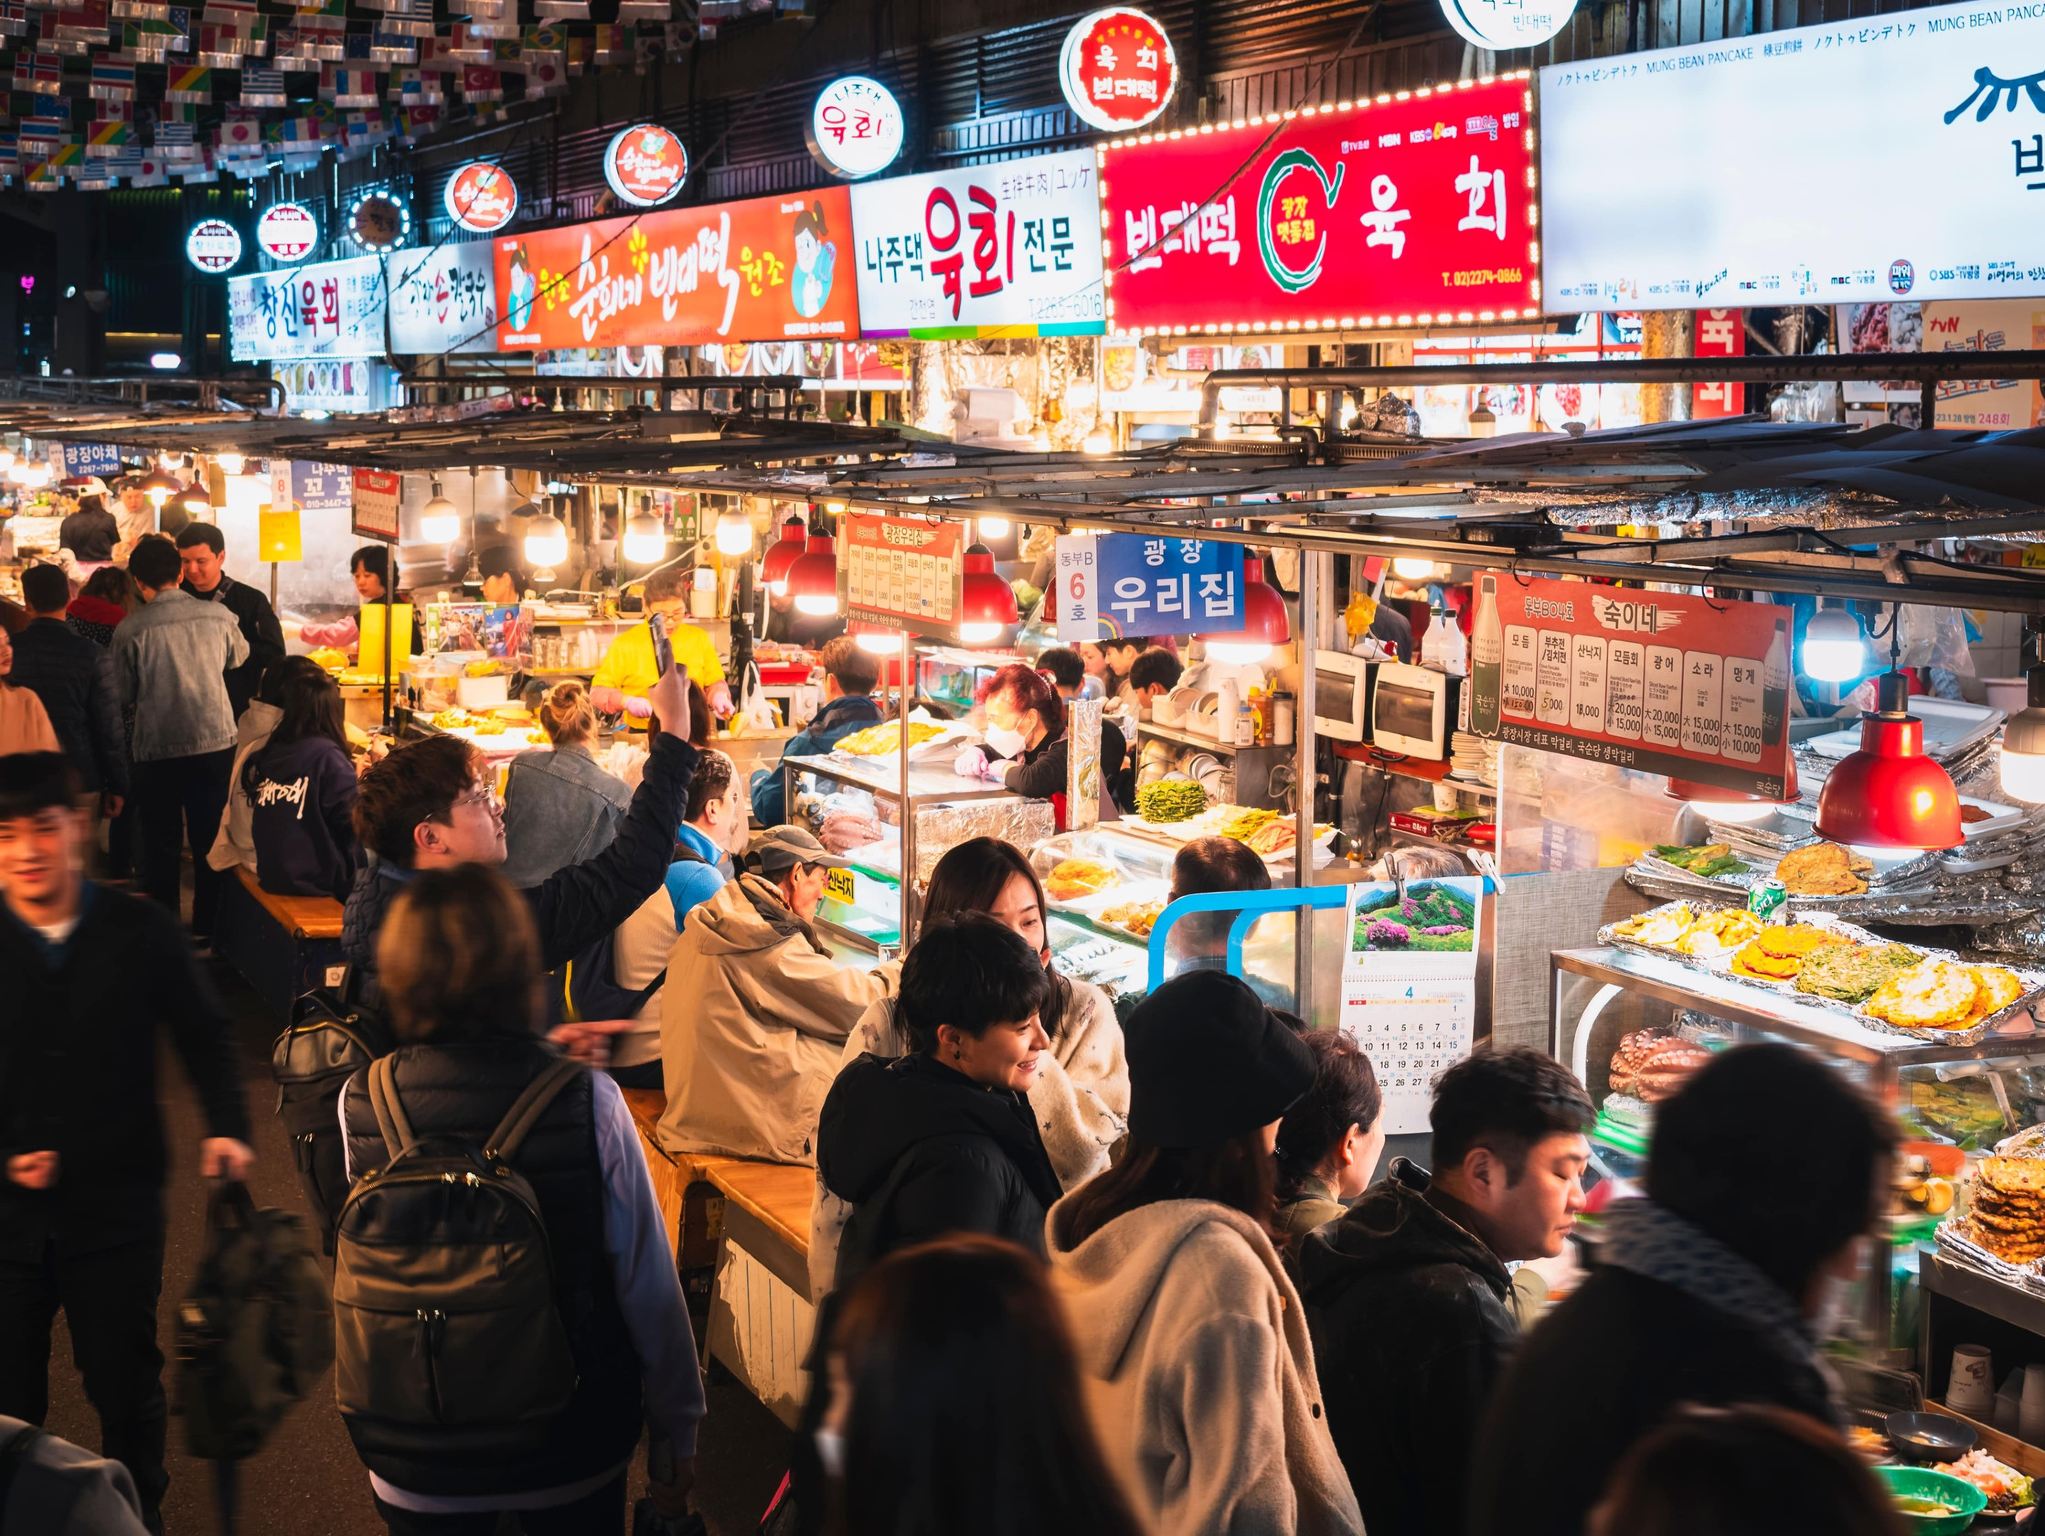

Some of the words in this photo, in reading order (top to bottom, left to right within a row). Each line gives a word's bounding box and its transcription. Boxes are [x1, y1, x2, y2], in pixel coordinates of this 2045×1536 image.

[1927, 15, 1965, 33] MUNG
[1969, 11, 2003, 28] BEAN
[1646, 56, 1677, 73] MUNG
[1678, 53, 1705, 70] BEAN
[1707, 46, 1755, 65] PANCAKE
[1092, 76, 1158, 103] 빈대떡
[822, 105, 882, 145] 육회
[1125, 194, 1241, 274] 빈대떡
[864, 231, 924, 284] 나주댁
[924, 184, 1016, 322] 육회
[1022, 216, 1075, 273] 전문
[538, 268, 572, 311] 원조
[568, 233, 643, 342] 순희네
[650, 210, 740, 336] 빈대떡
[738, 245, 785, 297] 원조
[1454, 267, 1523, 287] 02)2274-0866
[255, 276, 342, 340] 창신육회
[1930, 316, 1960, 333] tvN
[1978, 412, 2011, 426] 248회
[66, 444, 118, 465] 광장야채
[277, 480, 285, 492] 8
[1060, 551, 1093, 567] 동부B
[1069, 572, 1086, 601] 6
[1110, 570, 1236, 624] 우리집
[1070, 604, 1087, 622] 호
[1603, 600, 1658, 635] 숙이네
[1544, 635, 1566, 651] 부추전
[1541, 648, 1568, 665] /김치전
[1577, 643, 1603, 661] 산낙지
[1613, 649, 1639, 667] 모듬회
[1511, 684, 1535, 698] 10,000
[1615, 702, 1641, 718] 20,000
[1644, 708, 1652, 720] 大
[1652, 708, 1680, 724] 20,000
[1616, 717, 1641, 732] 15,000
[1643, 723, 1652, 734] 小
[1653, 724, 1679, 740] 15,000
[1683, 715, 1691, 728] 大
[1693, 716, 1720, 732] 15,000
[1722, 722, 1732, 734] 大
[1733, 723, 1761, 740] 15,000
[1501, 725, 1532, 745] 광장시장
[1533, 731, 1549, 747] 대표
[1550, 735, 1576, 754] 막걸리,
[1577, 741, 1602, 758] 국순당
[1602, 746, 1635, 765] 생막걸리
[1682, 730, 1691, 742] 小
[1692, 731, 1719, 747] 10,000
[1721, 738, 1731, 750] 小
[1732, 739, 1761, 755] 10,000
[828, 869, 855, 900] 산낙지
[1405, 986, 1414, 998] 4
[1452, 1005, 1458, 1013] 1
[1350, 1025, 1356, 1033] 2
[1367, 1024, 1373, 1033] 3
[1384, 1024, 1390, 1032] 4
[1401, 1024, 1407, 1032] 5
[1418, 1024, 1424, 1032] 6
[1435, 1023, 1441, 1032] 7
[1451, 1023, 1457, 1031] 8
[1364, 1043, 1374, 1052] 10
[1381, 1042, 1390, 1051] 11
[1398, 1042, 1408, 1051] 12
[1415, 1042, 1425, 1051] 13
[1432, 1041, 1441, 1050] 14
[1449, 1040, 1458, 1050] 15
[1380, 1061, 1390, 1070] 18
[1397, 1060, 1407, 1069] 19
[1413, 1060, 1424, 1069] 20
[1430, 1059, 1440, 1068] 21
[1378, 1079, 1389, 1088] 25
[1395, 1078, 1405, 1088] 26
[1412, 1078, 1423, 1087] 27
